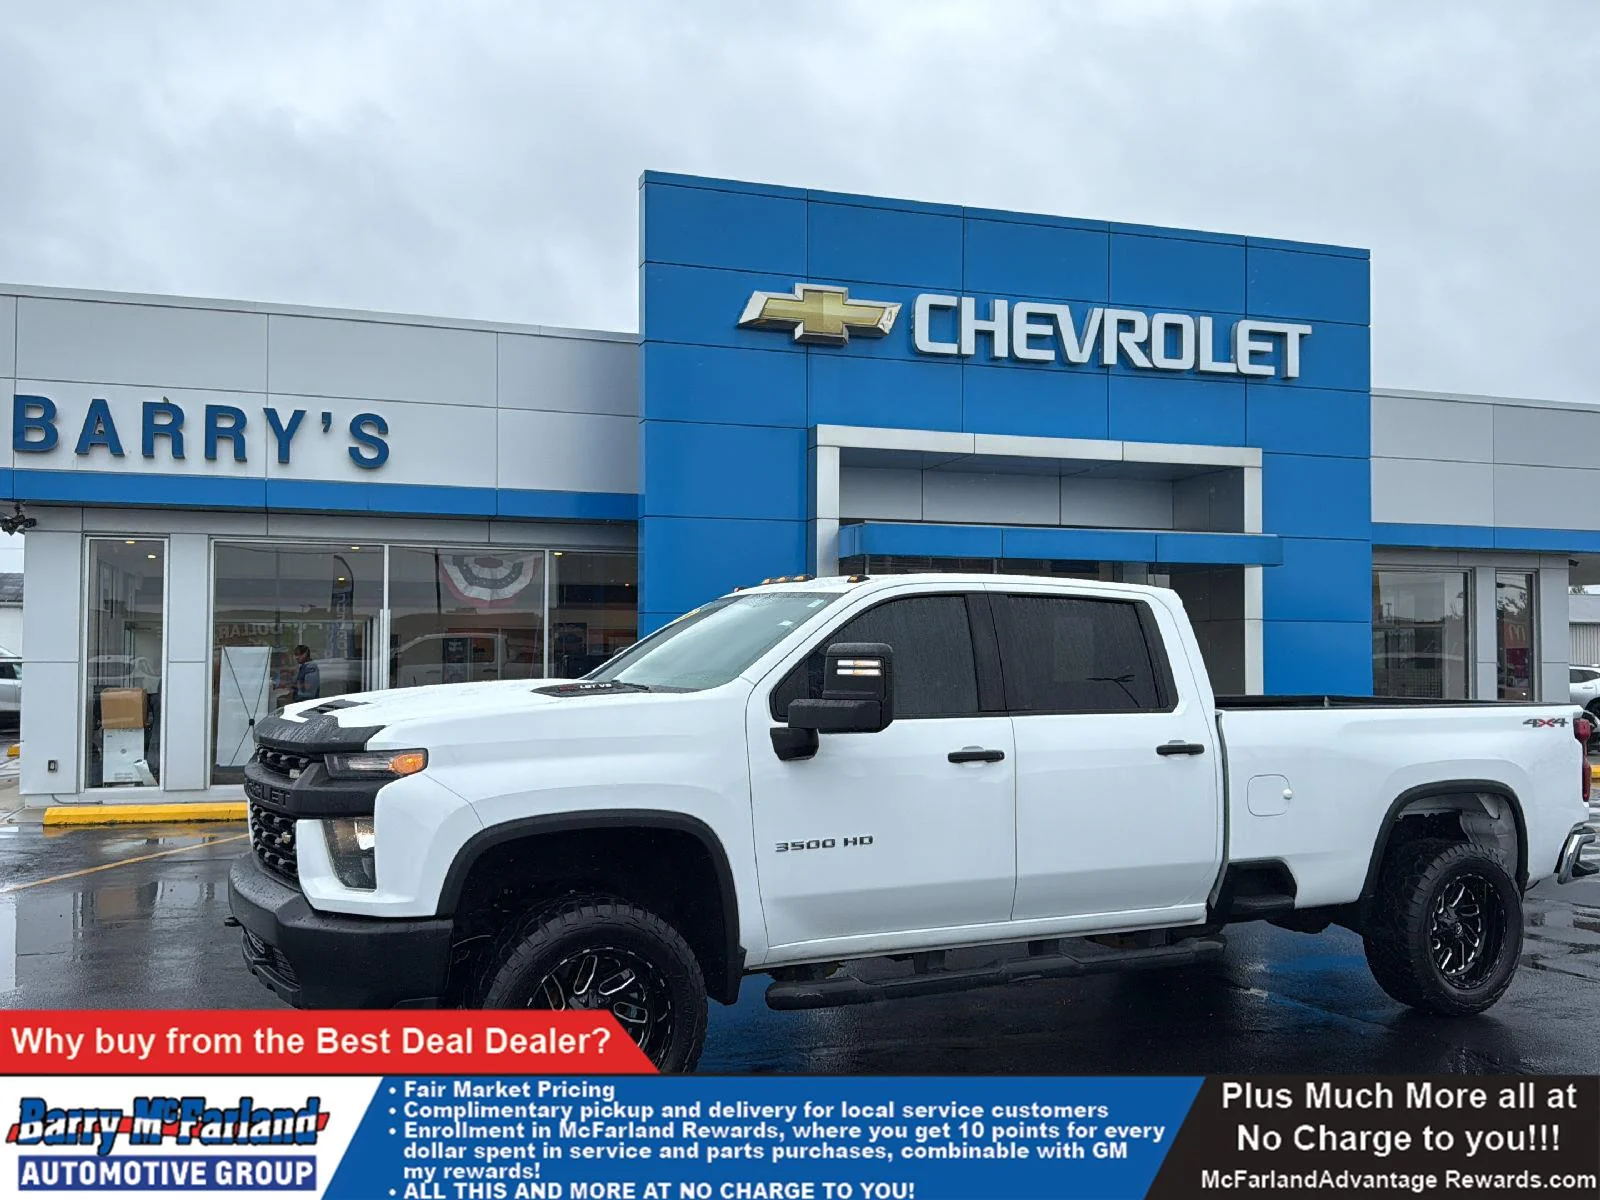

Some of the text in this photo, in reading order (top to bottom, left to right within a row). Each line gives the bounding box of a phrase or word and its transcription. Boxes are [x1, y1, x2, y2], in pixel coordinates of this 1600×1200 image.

[911, 293, 1313, 380] CHEVROLET
[13, 394, 391, 470] BARRY'S
[775, 835, 874, 853] 3500 HD
